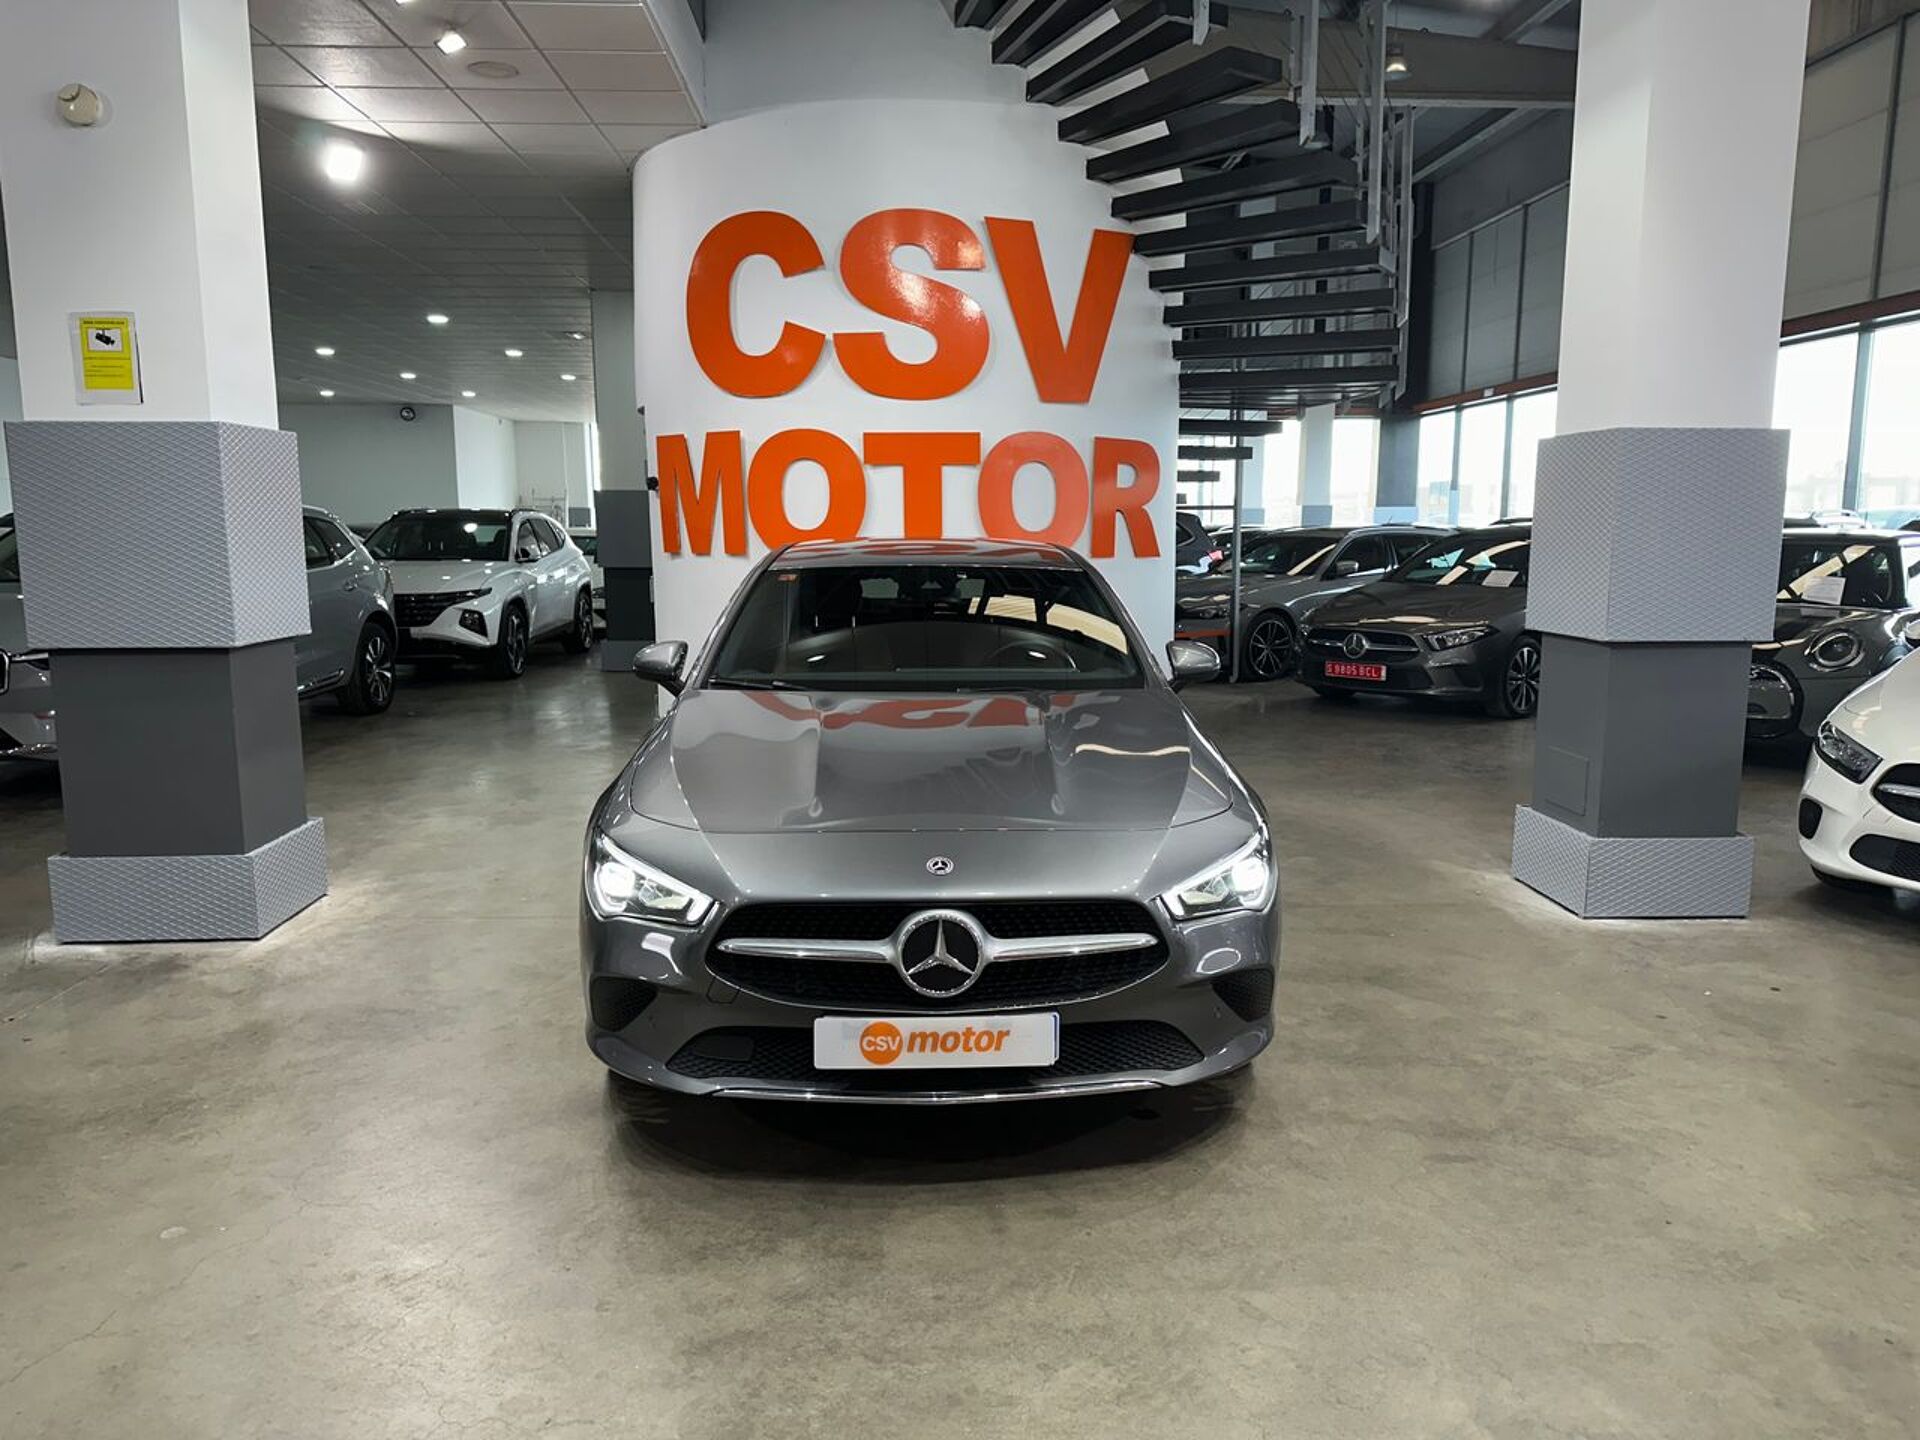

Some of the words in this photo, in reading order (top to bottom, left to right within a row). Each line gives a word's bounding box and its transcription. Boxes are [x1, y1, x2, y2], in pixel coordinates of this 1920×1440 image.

[686, 208, 1134, 404] CSV
[656, 428, 1160, 558] MOTOR
[862, 1035, 900, 1052] CSV
[907, 1027, 1010, 1053] motor
